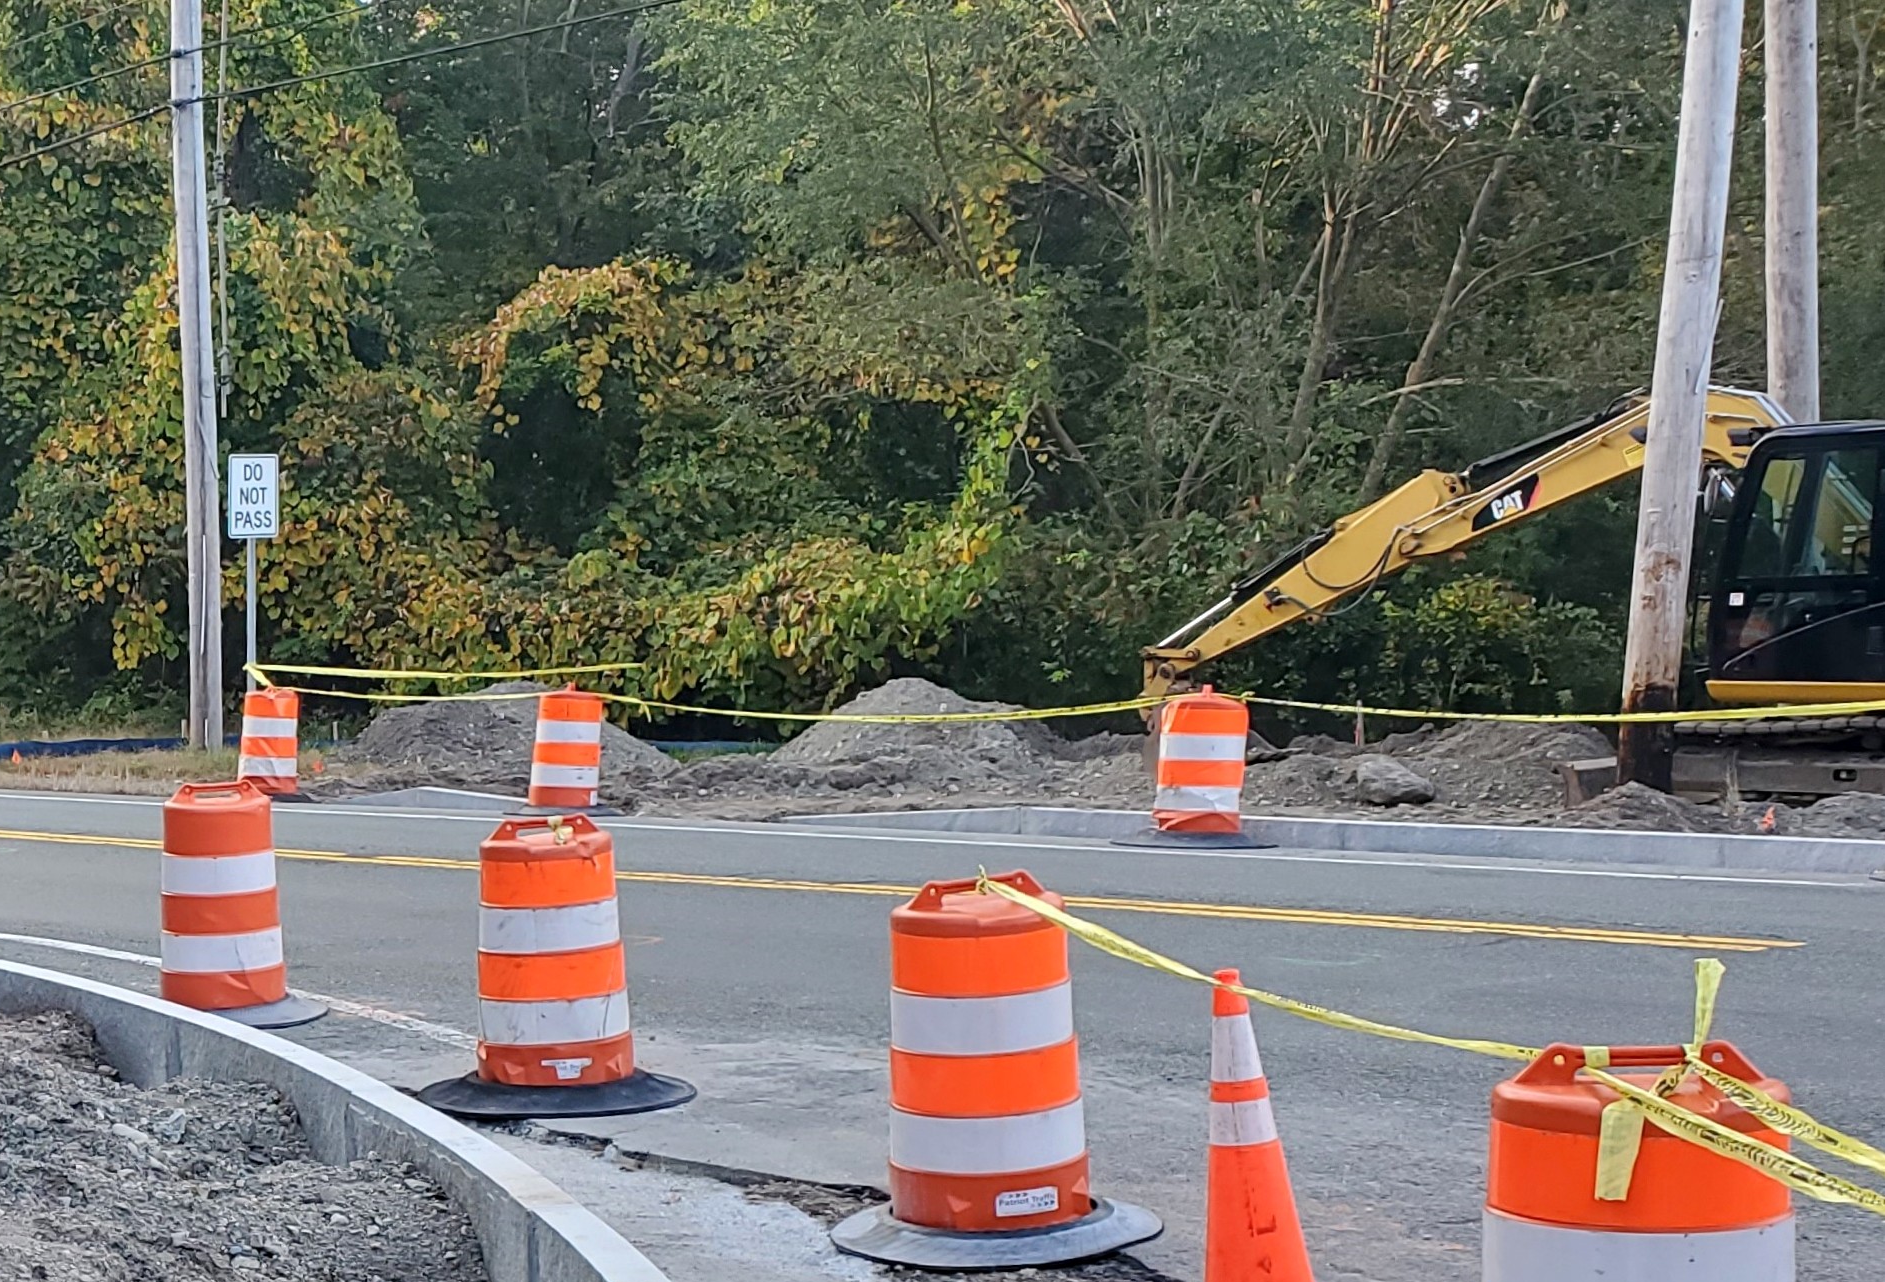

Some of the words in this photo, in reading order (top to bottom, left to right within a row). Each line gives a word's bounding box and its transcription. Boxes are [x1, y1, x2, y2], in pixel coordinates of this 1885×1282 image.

[243, 463, 263, 482] DO
[239, 487, 268, 505] NOT
[1490, 490, 1525, 520] CAT
[234, 511, 272, 529] PASS
